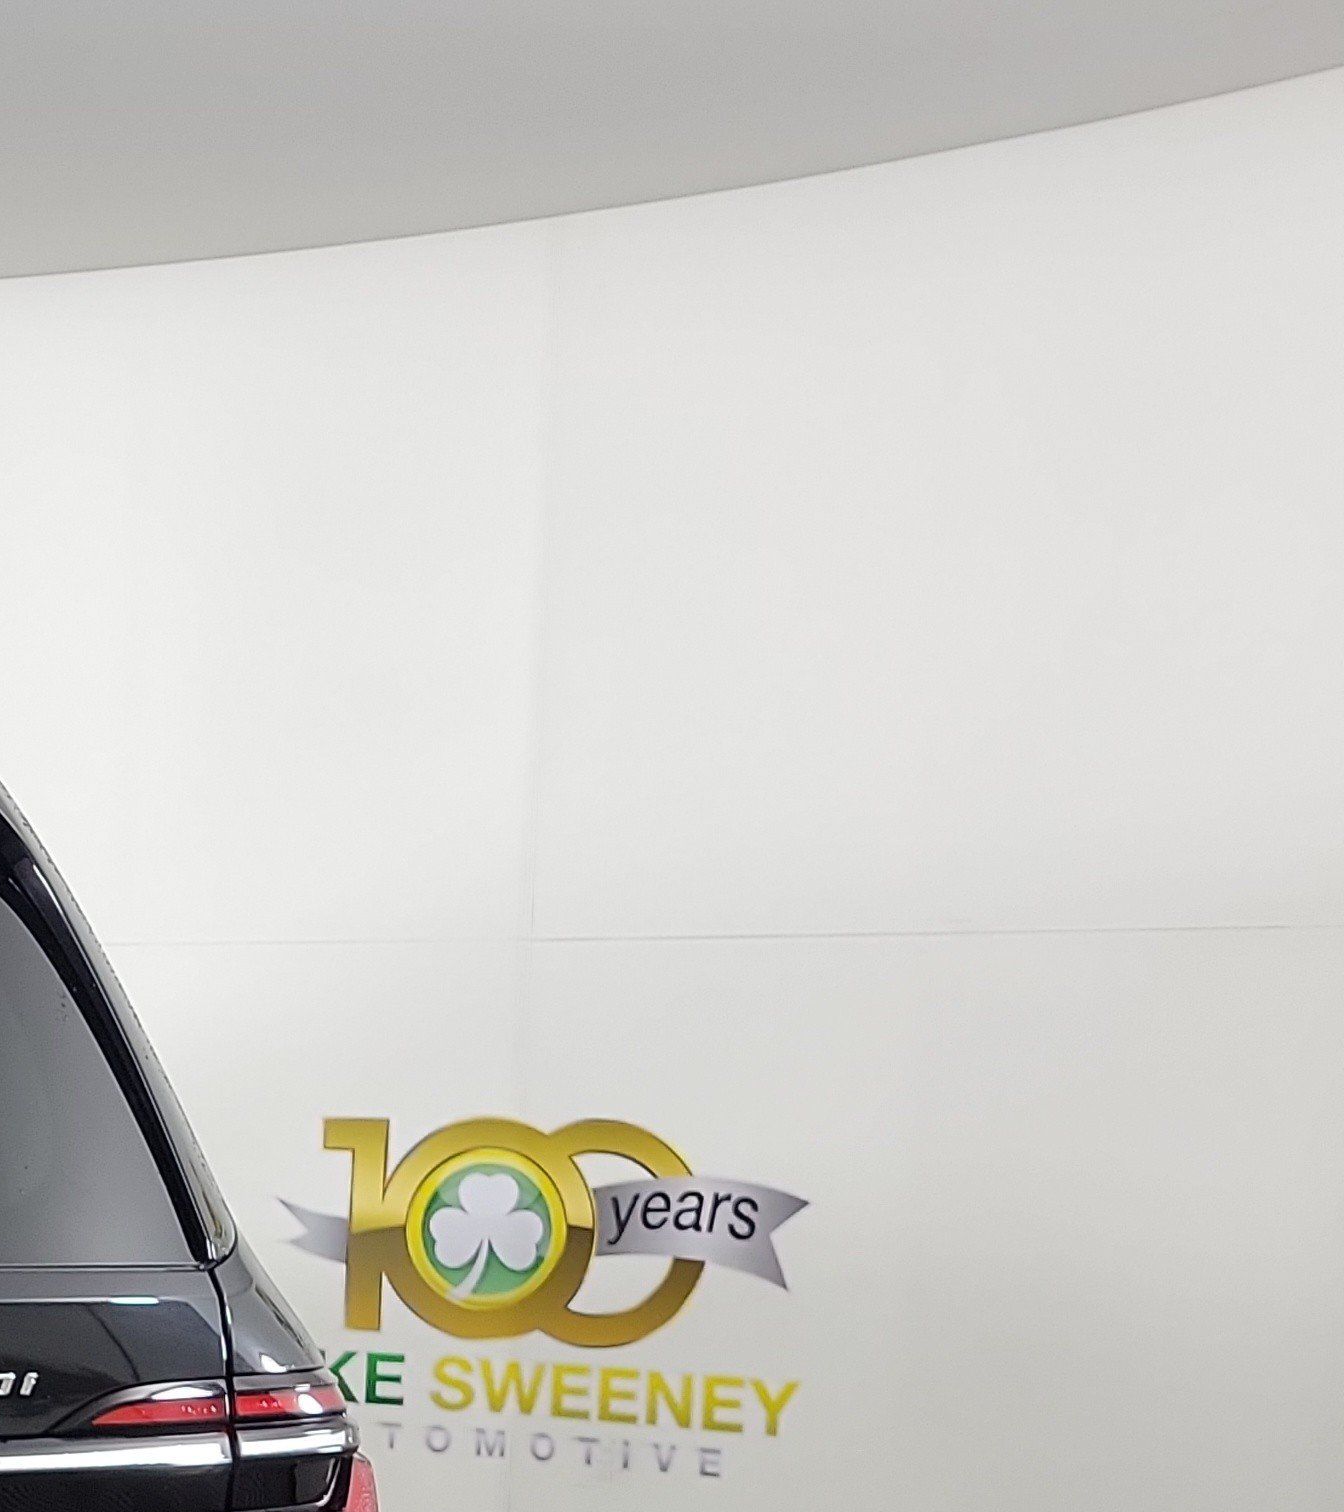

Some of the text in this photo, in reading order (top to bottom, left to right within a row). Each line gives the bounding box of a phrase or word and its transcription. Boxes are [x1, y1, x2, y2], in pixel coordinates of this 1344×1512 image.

[322, 1116, 706, 1348] 100
[608, 1189, 760, 1243] years
[428, 1354, 801, 1436] SWEENEY
